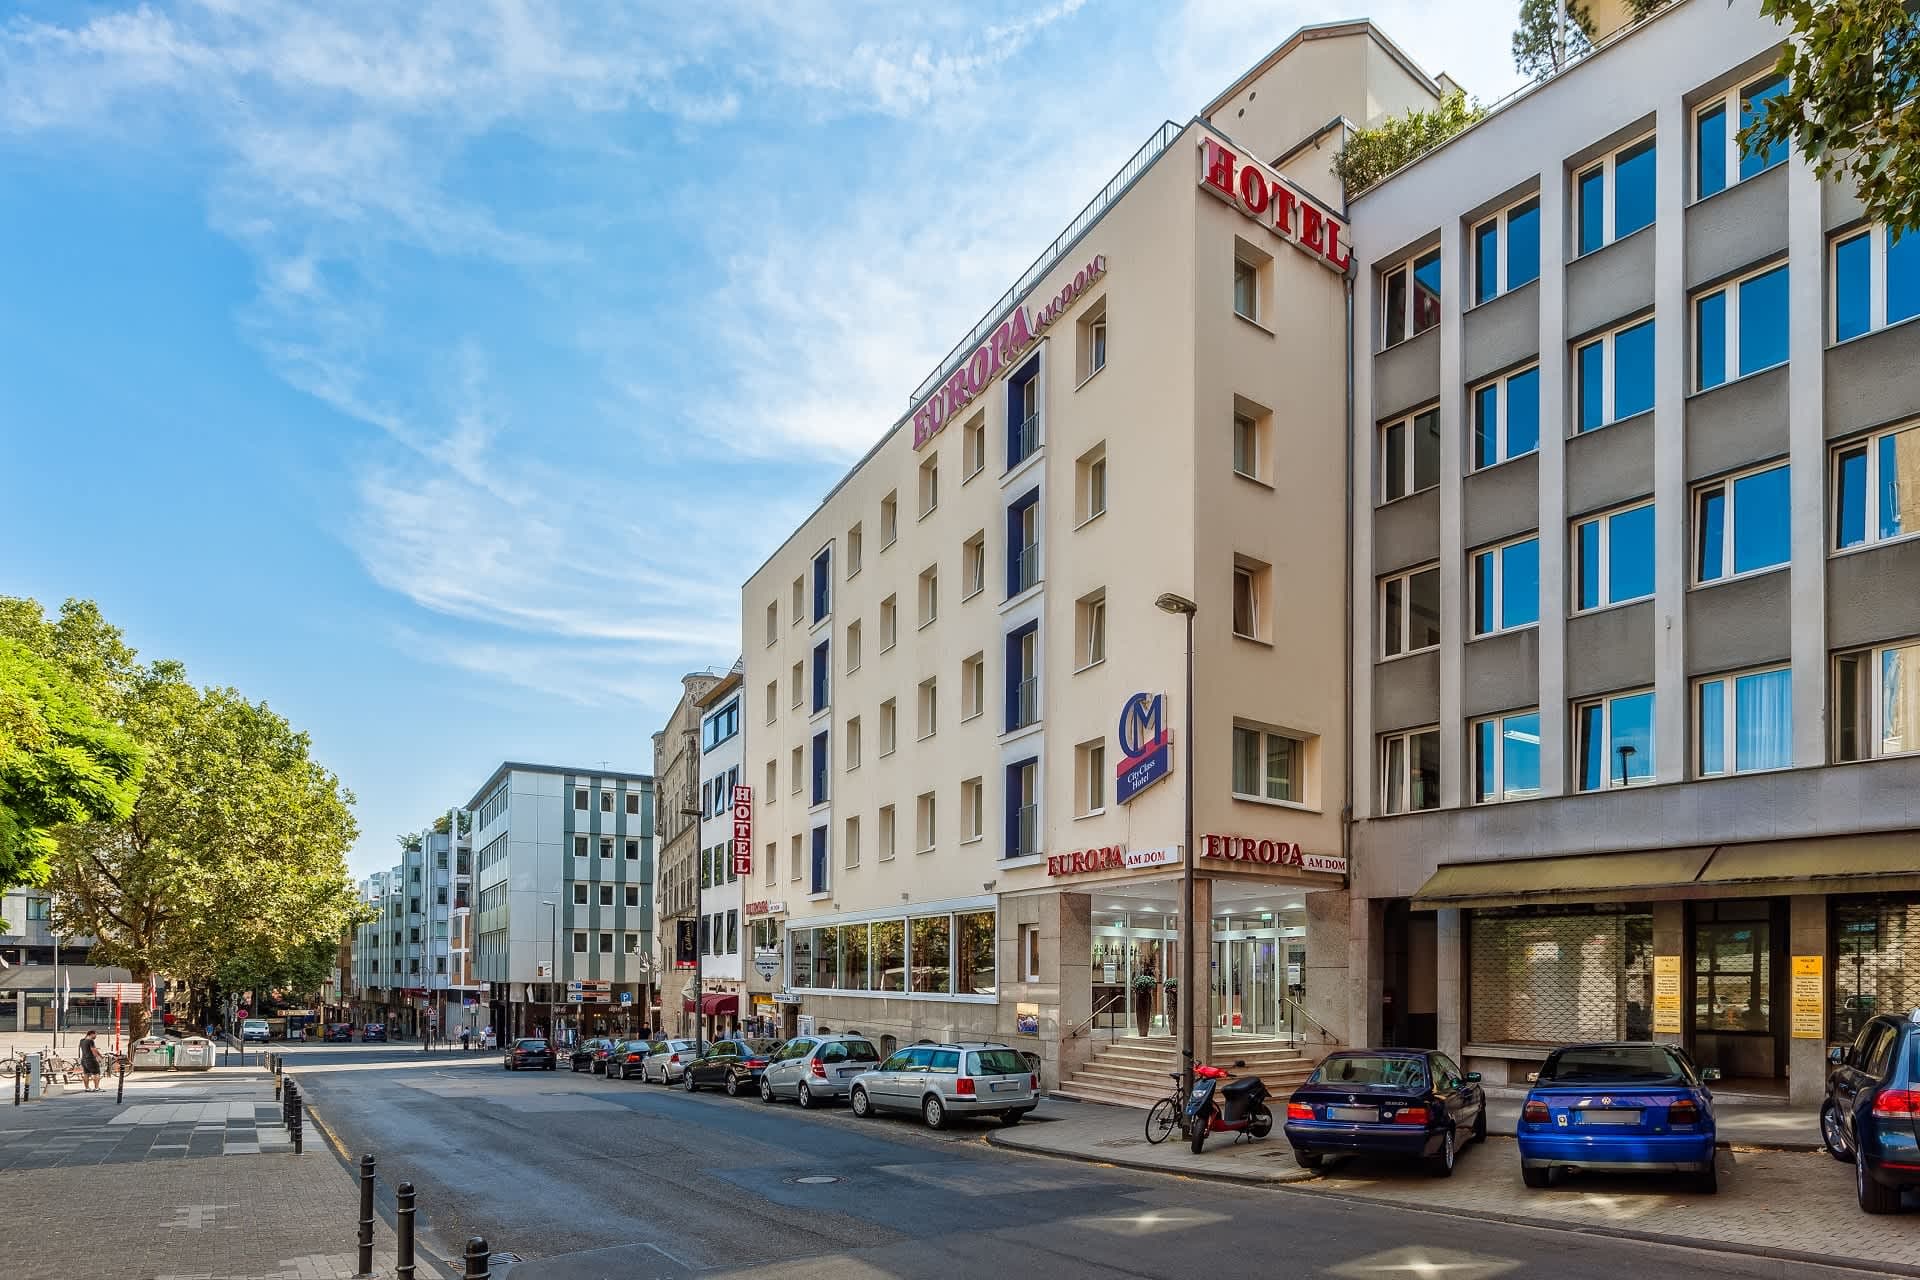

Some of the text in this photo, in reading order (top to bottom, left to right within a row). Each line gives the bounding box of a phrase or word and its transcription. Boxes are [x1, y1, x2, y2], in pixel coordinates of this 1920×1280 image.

[1204, 136, 1350, 271] HOTEL
[912, 254, 1104, 451] EUROPA AM DOM
[1132, 771, 1149, 791] Hotel
[735, 787, 750, 873] HOTEL
[1047, 844, 1166, 877] EUROPA AM DOM
[1206, 834, 1346, 870] EUROPA AM DOM
